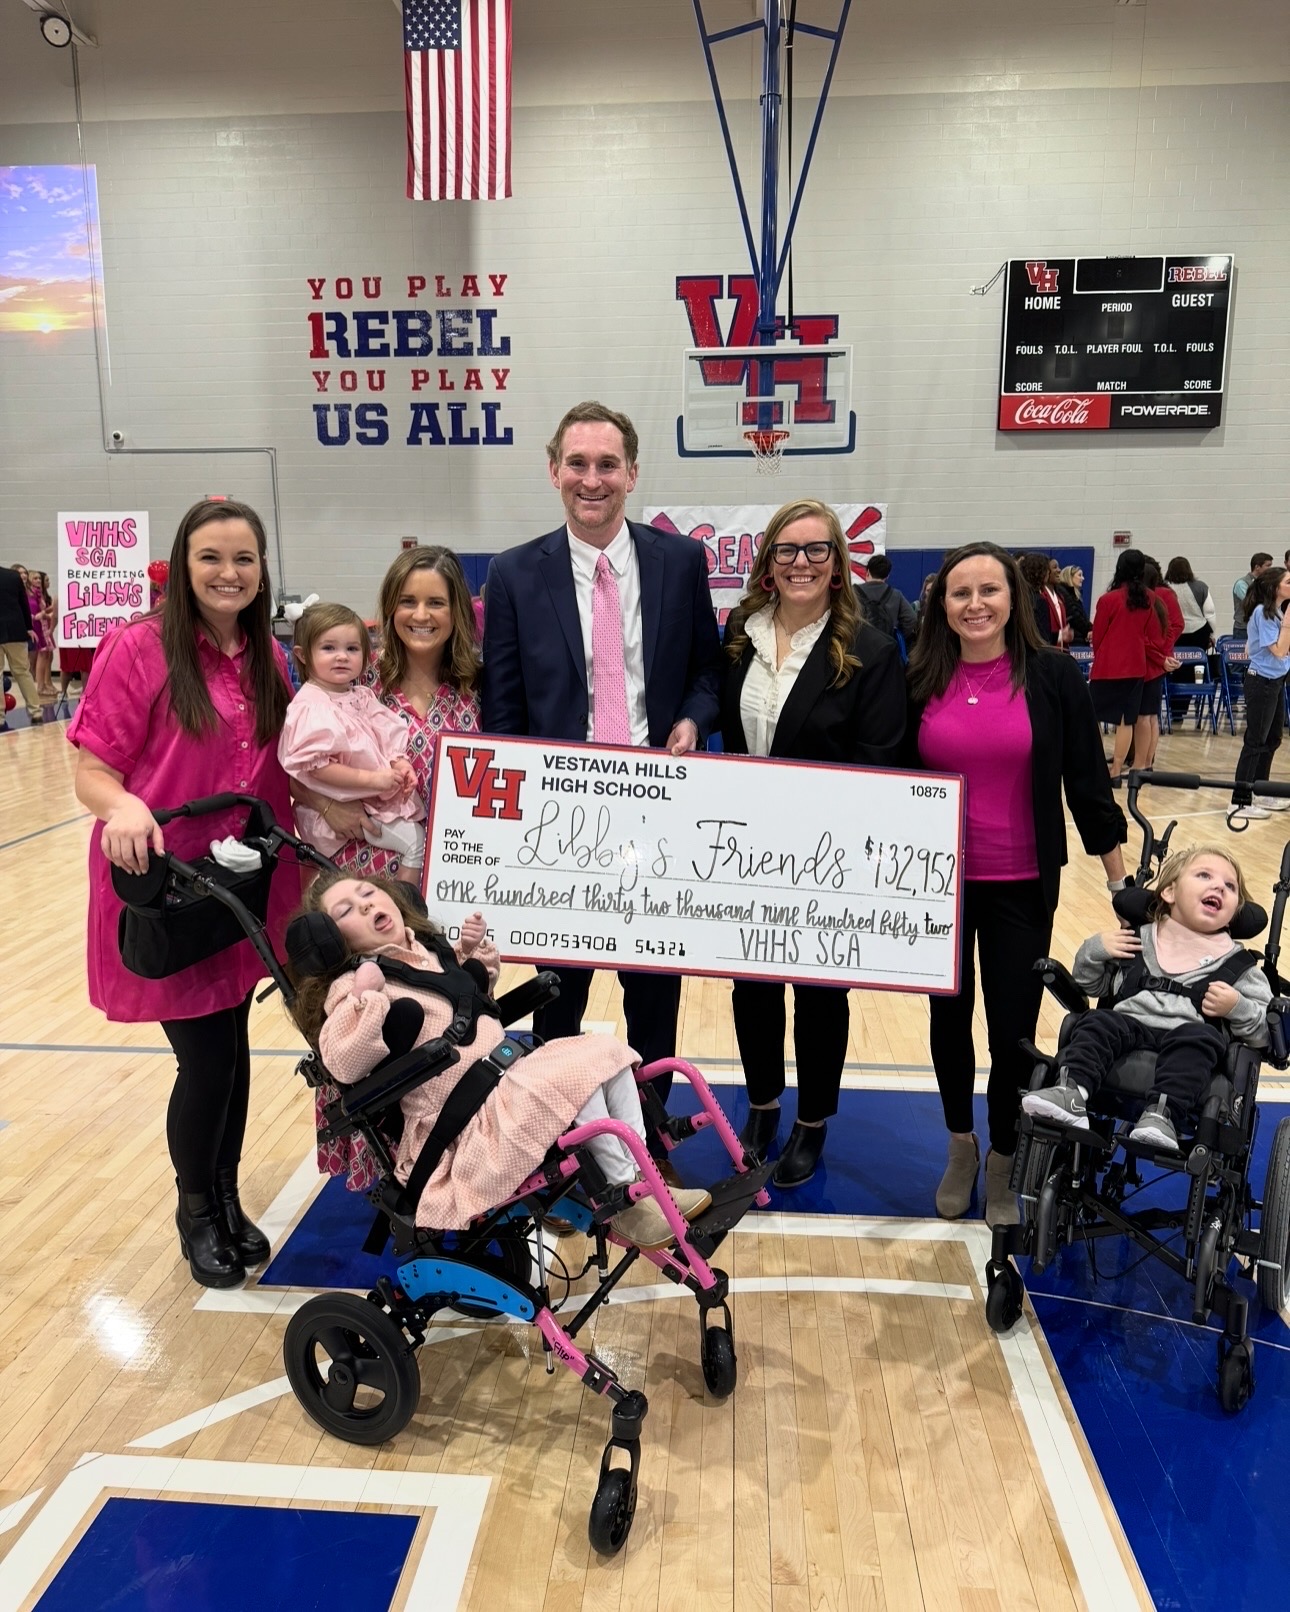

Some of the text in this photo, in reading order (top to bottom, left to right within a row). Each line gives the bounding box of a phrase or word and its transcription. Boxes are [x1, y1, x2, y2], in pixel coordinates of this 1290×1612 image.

[307, 274, 508, 300] YOU PLAY
[1024, 296, 1061, 310] HOME
[1172, 293, 1214, 307] GUEST
[1101, 302, 1132, 313] PERIOD
[1016, 345, 1043, 355] FOULS
[1055, 345, 1078, 354] T.O.L.
[1086, 343, 1143, 354] PLAYER FOUL
[1153, 343, 1177, 353] T.O.L.
[1186, 342, 1214, 352] FOULS
[312, 368, 510, 392] YOU PLAY
[1015, 382, 1043, 392] SCORE
[1097, 381, 1127, 391] MATCH
[1184, 380, 1212, 390] SCORE
[1015, 398, 1094, 425] Coca-Cola
[312, 402, 514, 446] US ALL
[65, 518, 137, 548] VHHS
[75, 547, 117, 568] SGA
[543, 754, 687, 780] VESTAVIA HILLS
[446, 745, 526, 820] VH
[541, 776, 671, 801] HIGH SCHOOL
[910, 785, 947, 799] 10875
[444, 828, 465, 839] PAY
[443, 841, 483, 853] TO THE
[442, 853, 500, 866] ORDER OF
[692, 820, 852, 889] Friends
[864, 835, 956, 897] $132,952
[436, 873, 954, 946] one hundred thirty two thousand nine hundred fifty two
[739, 928, 861, 967] VHHS SGA
